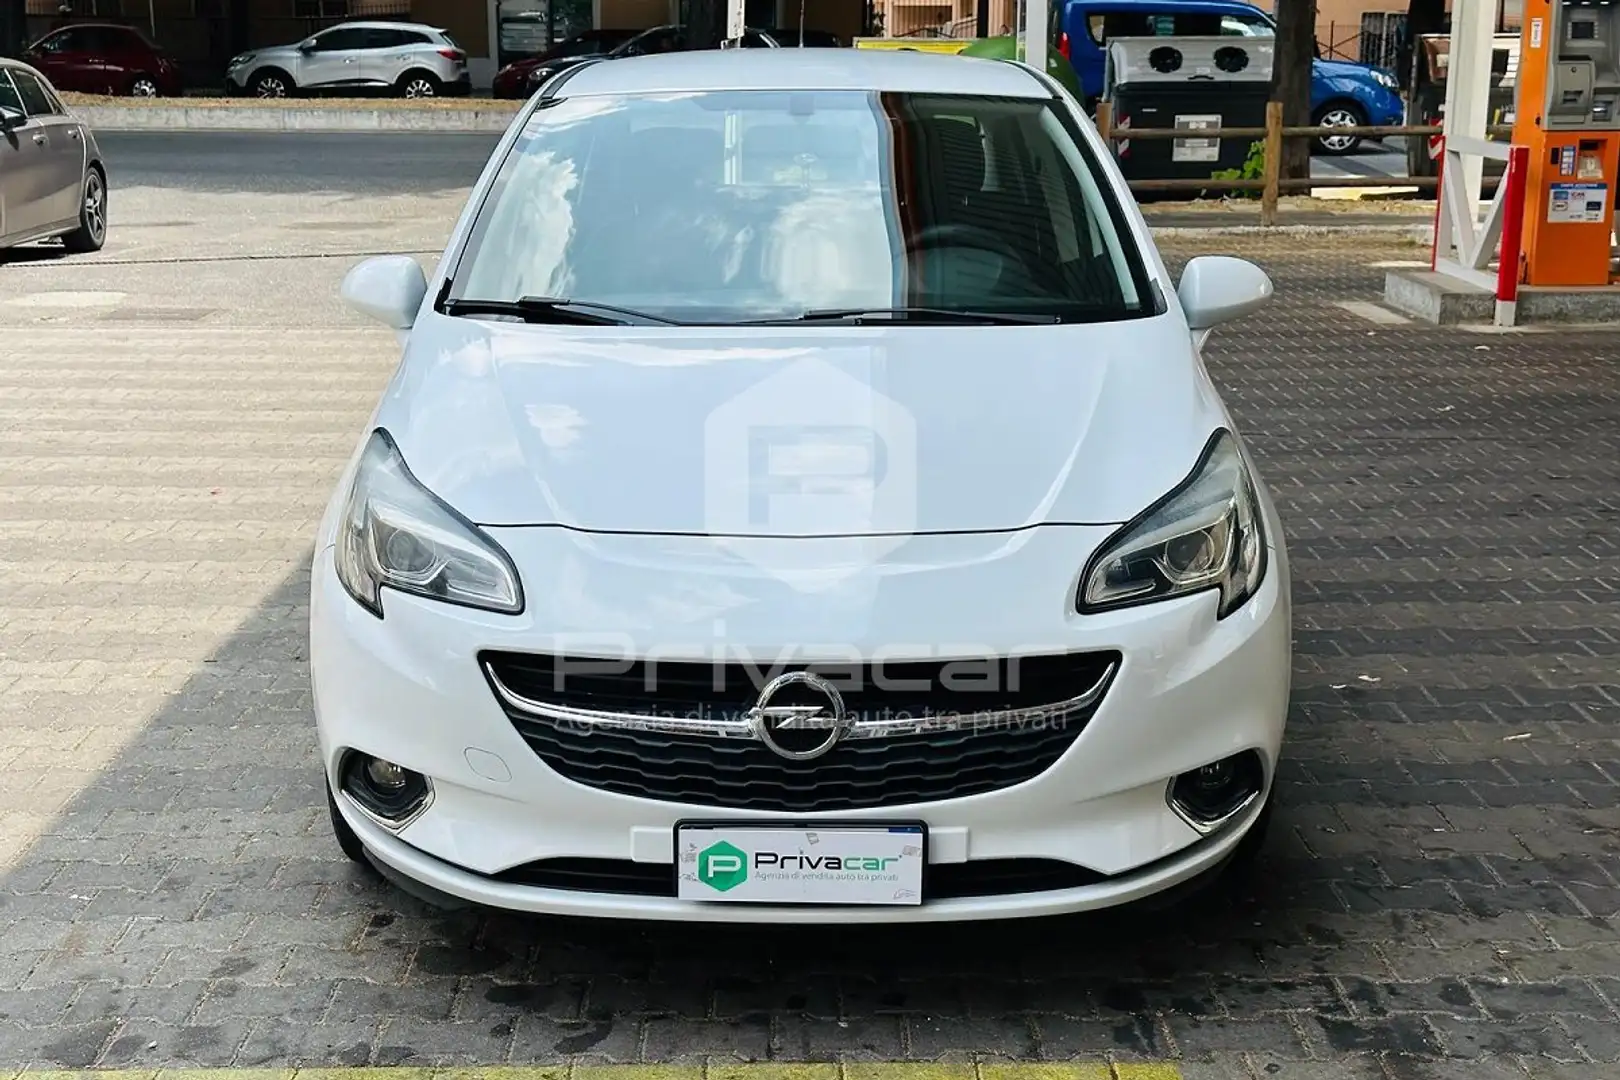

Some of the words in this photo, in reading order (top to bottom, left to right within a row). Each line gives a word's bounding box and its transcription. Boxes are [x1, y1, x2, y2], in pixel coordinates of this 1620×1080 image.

[708, 855, 741, 878] P
[754, 850, 899, 870] Privacar
[754, 871, 790, 881] Agenzia
[791, 871, 799, 880] di
[802, 871, 834, 880] vendita
[835, 872, 856, 881] auto
[857, 872, 869, 881] tra
[871, 873, 899, 882] privati
